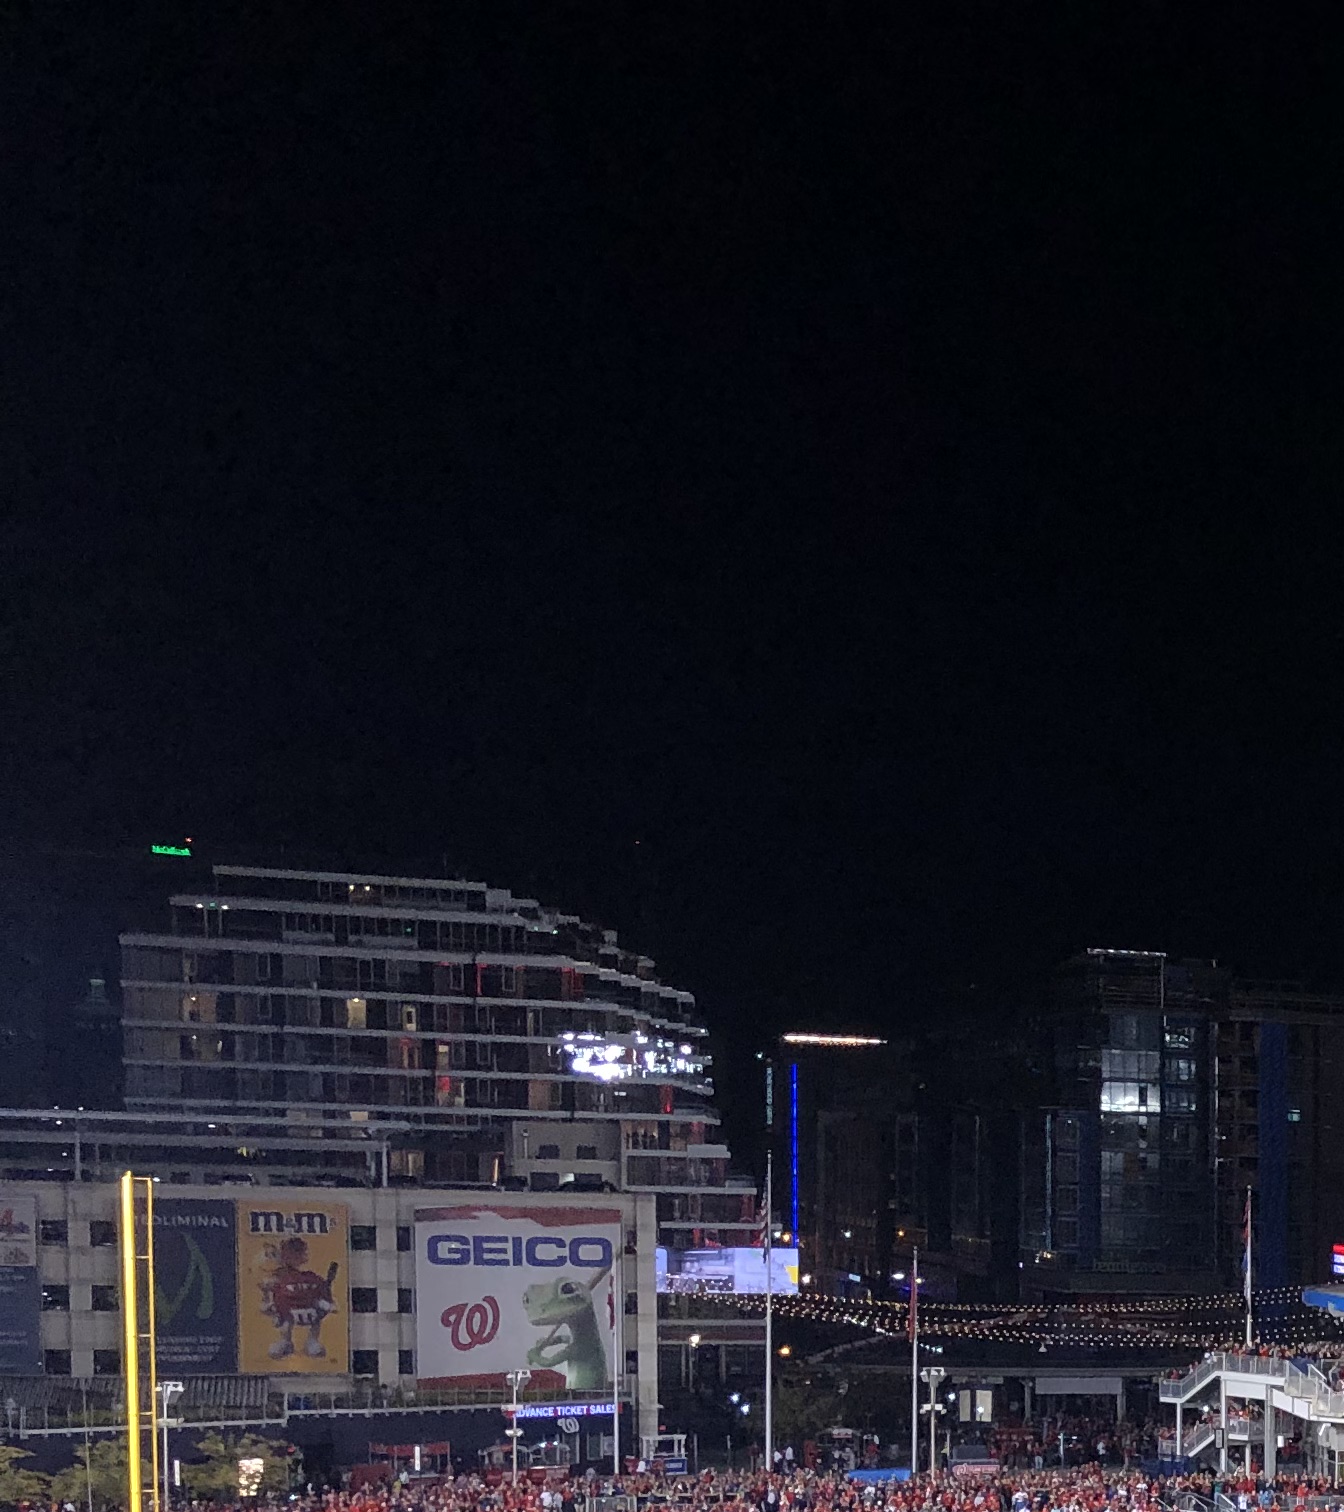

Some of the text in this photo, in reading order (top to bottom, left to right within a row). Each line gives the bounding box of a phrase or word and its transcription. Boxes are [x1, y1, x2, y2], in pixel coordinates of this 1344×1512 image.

[427, 1235, 613, 1267] GEICO
[556, 1405, 588, 1416] TICKET
[590, 1404, 616, 1414] SALES
